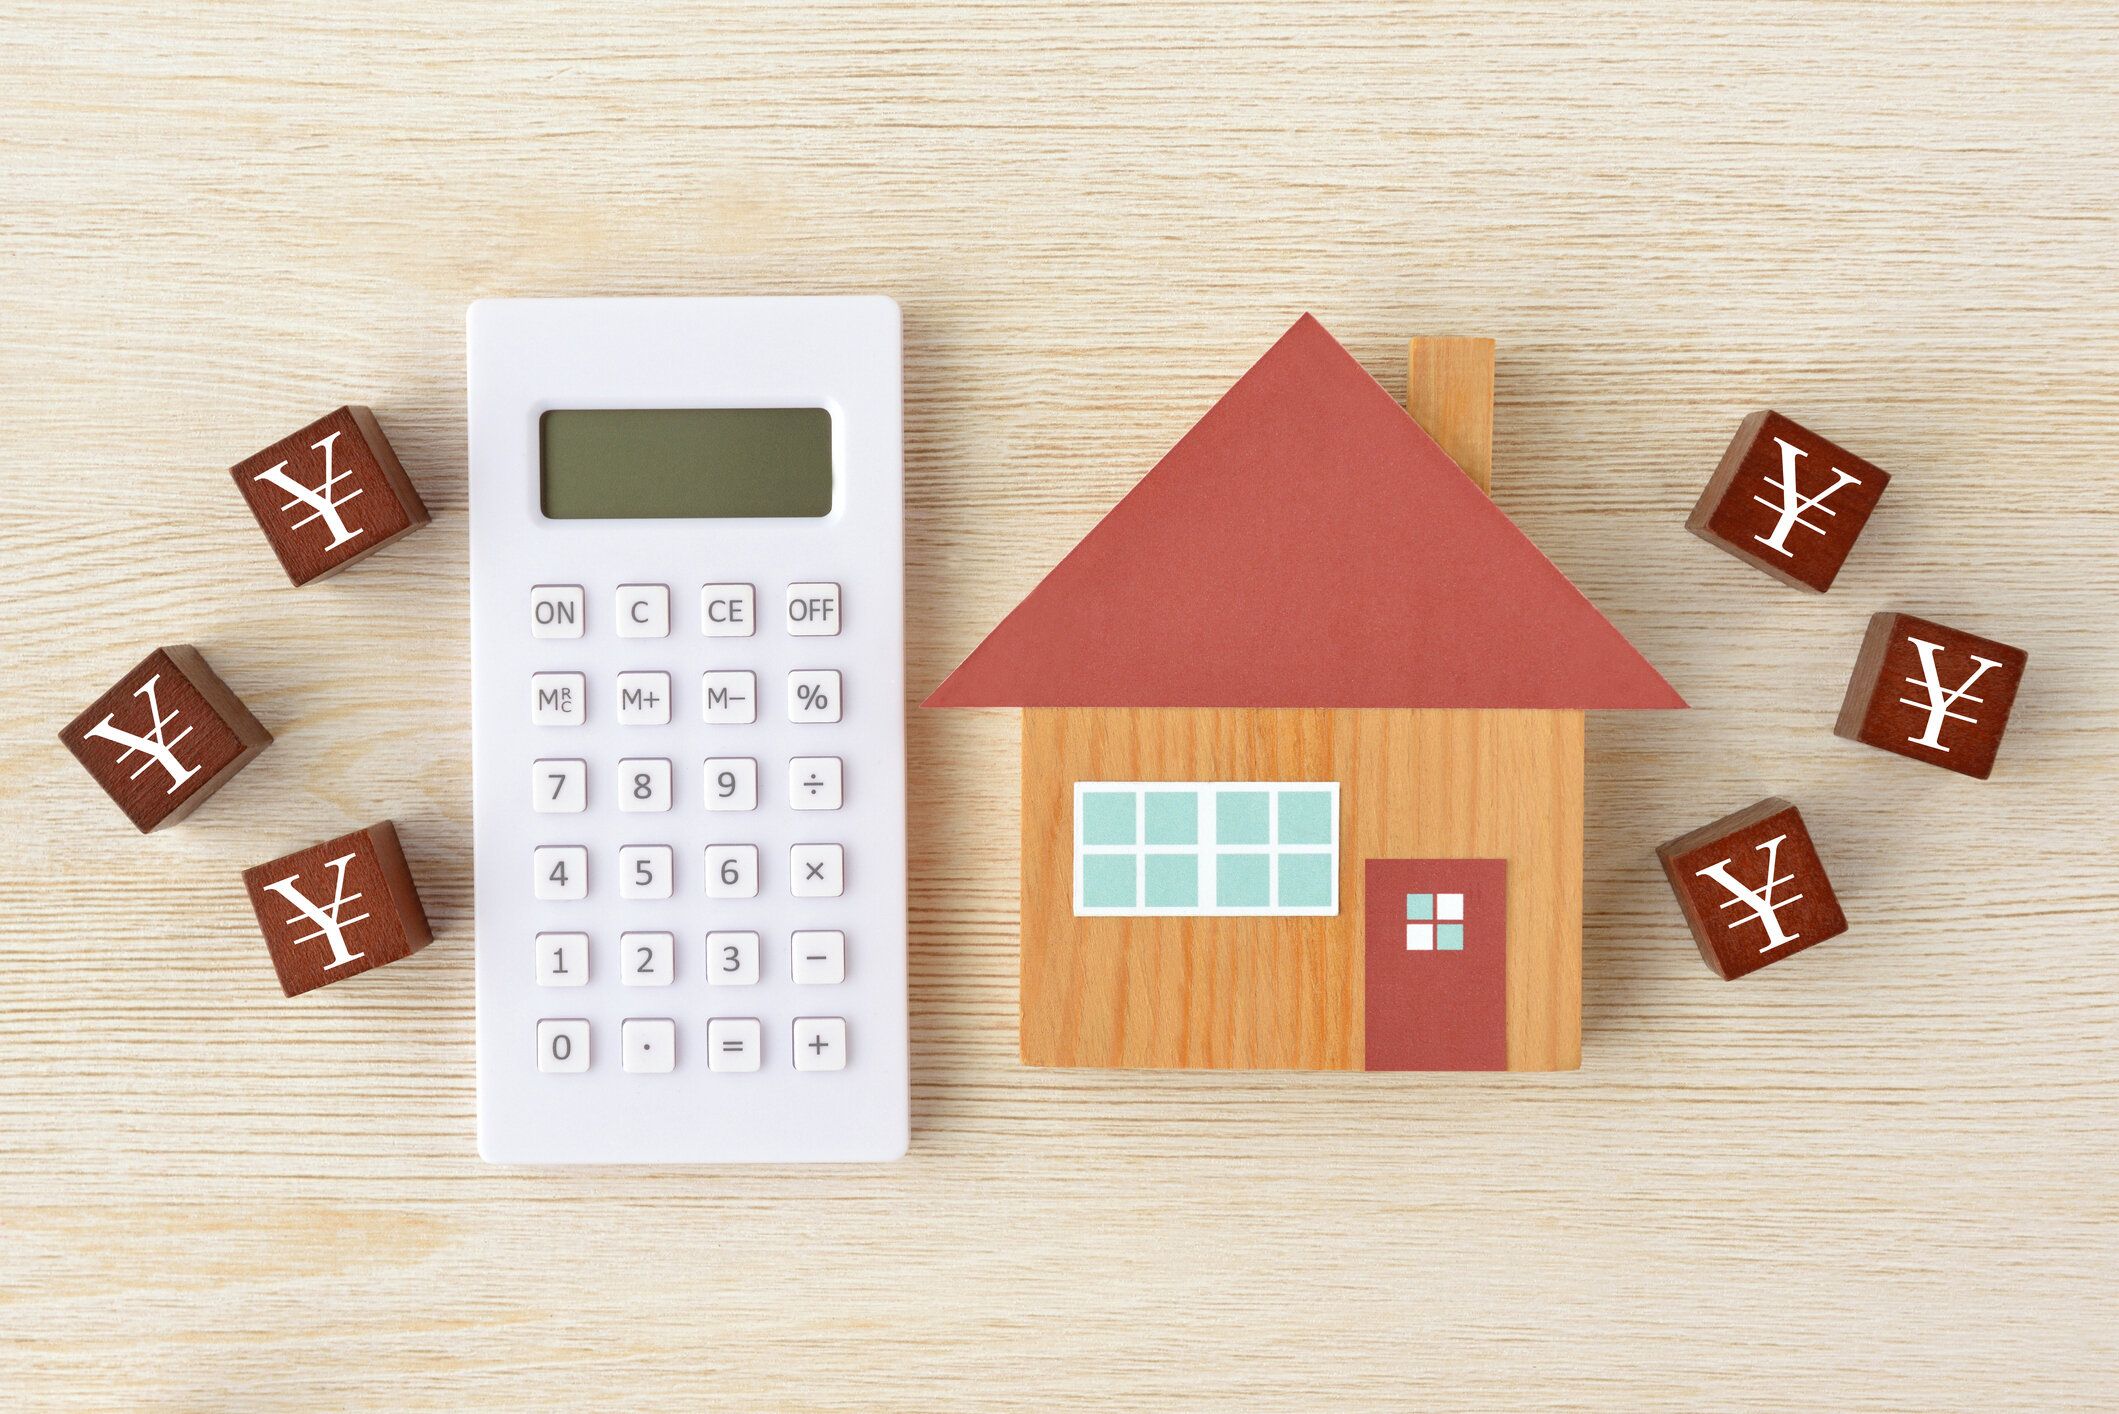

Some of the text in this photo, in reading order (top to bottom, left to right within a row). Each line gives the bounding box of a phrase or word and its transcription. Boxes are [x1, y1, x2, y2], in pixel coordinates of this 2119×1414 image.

[254, 431, 363, 552] ¥
[1754, 437, 1861, 557] ¥
[536, 600, 575, 625] ON
[630, 600, 649, 624] C
[709, 599, 744, 623] CE
[790, 598, 834, 622] OFF
[623, 688, 660, 711] M+
[796, 684, 828, 711] %
[1900, 636, 2002, 752] ¥
[84, 674, 201, 794] ¥
[548, 774, 566, 800] 7
[633, 773, 652, 800] 8
[717, 771, 736, 798] 9
[548, 860, 569, 887] 4
[635, 859, 653, 886] 5
[720, 858, 739, 886] 6
[1696, 835, 1802, 953] ¥
[263, 853, 369, 970] ¥
[552, 947, 569, 974] 1
[636, 946, 655, 973] 2
[722, 945, 741, 973] 3
[552, 1034, 572, 1061] 0
[722, 1040, 744, 1052] =
[808, 1034, 829, 1056] +
